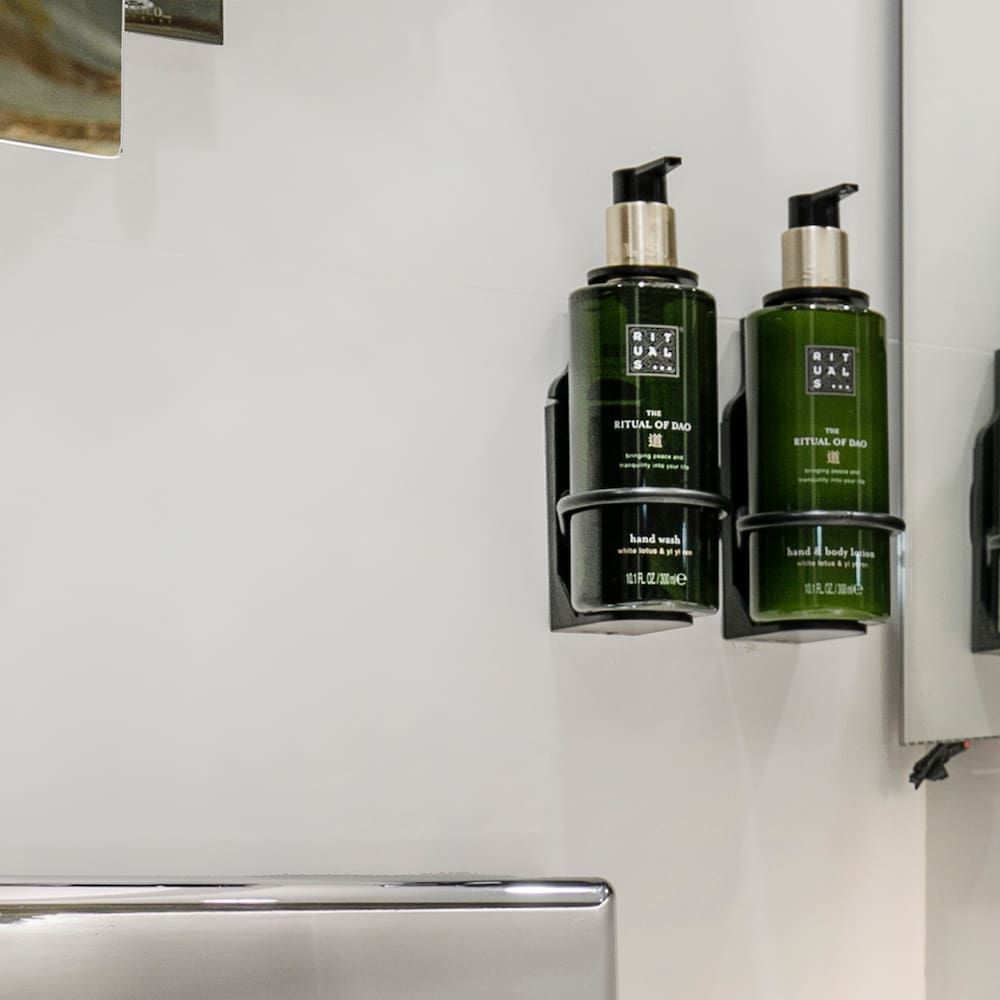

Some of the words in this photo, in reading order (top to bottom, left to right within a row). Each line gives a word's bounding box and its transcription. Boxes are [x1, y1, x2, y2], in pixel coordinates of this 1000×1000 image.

[646, 409, 662, 417] THE
[614, 419, 652, 429] RITUAL
[654, 420, 670, 430] OF
[671, 421, 692, 432] DAO
[794, 436, 831, 446] RITUAL
[832, 438, 848, 447] OF
[848, 438, 868, 449] DAO
[630, 533, 656, 544] hand
[658, 534, 681, 545] wash
[787, 546, 812, 557] hand
[824, 546, 848, 559] body
[850, 547, 876, 558] lotion
